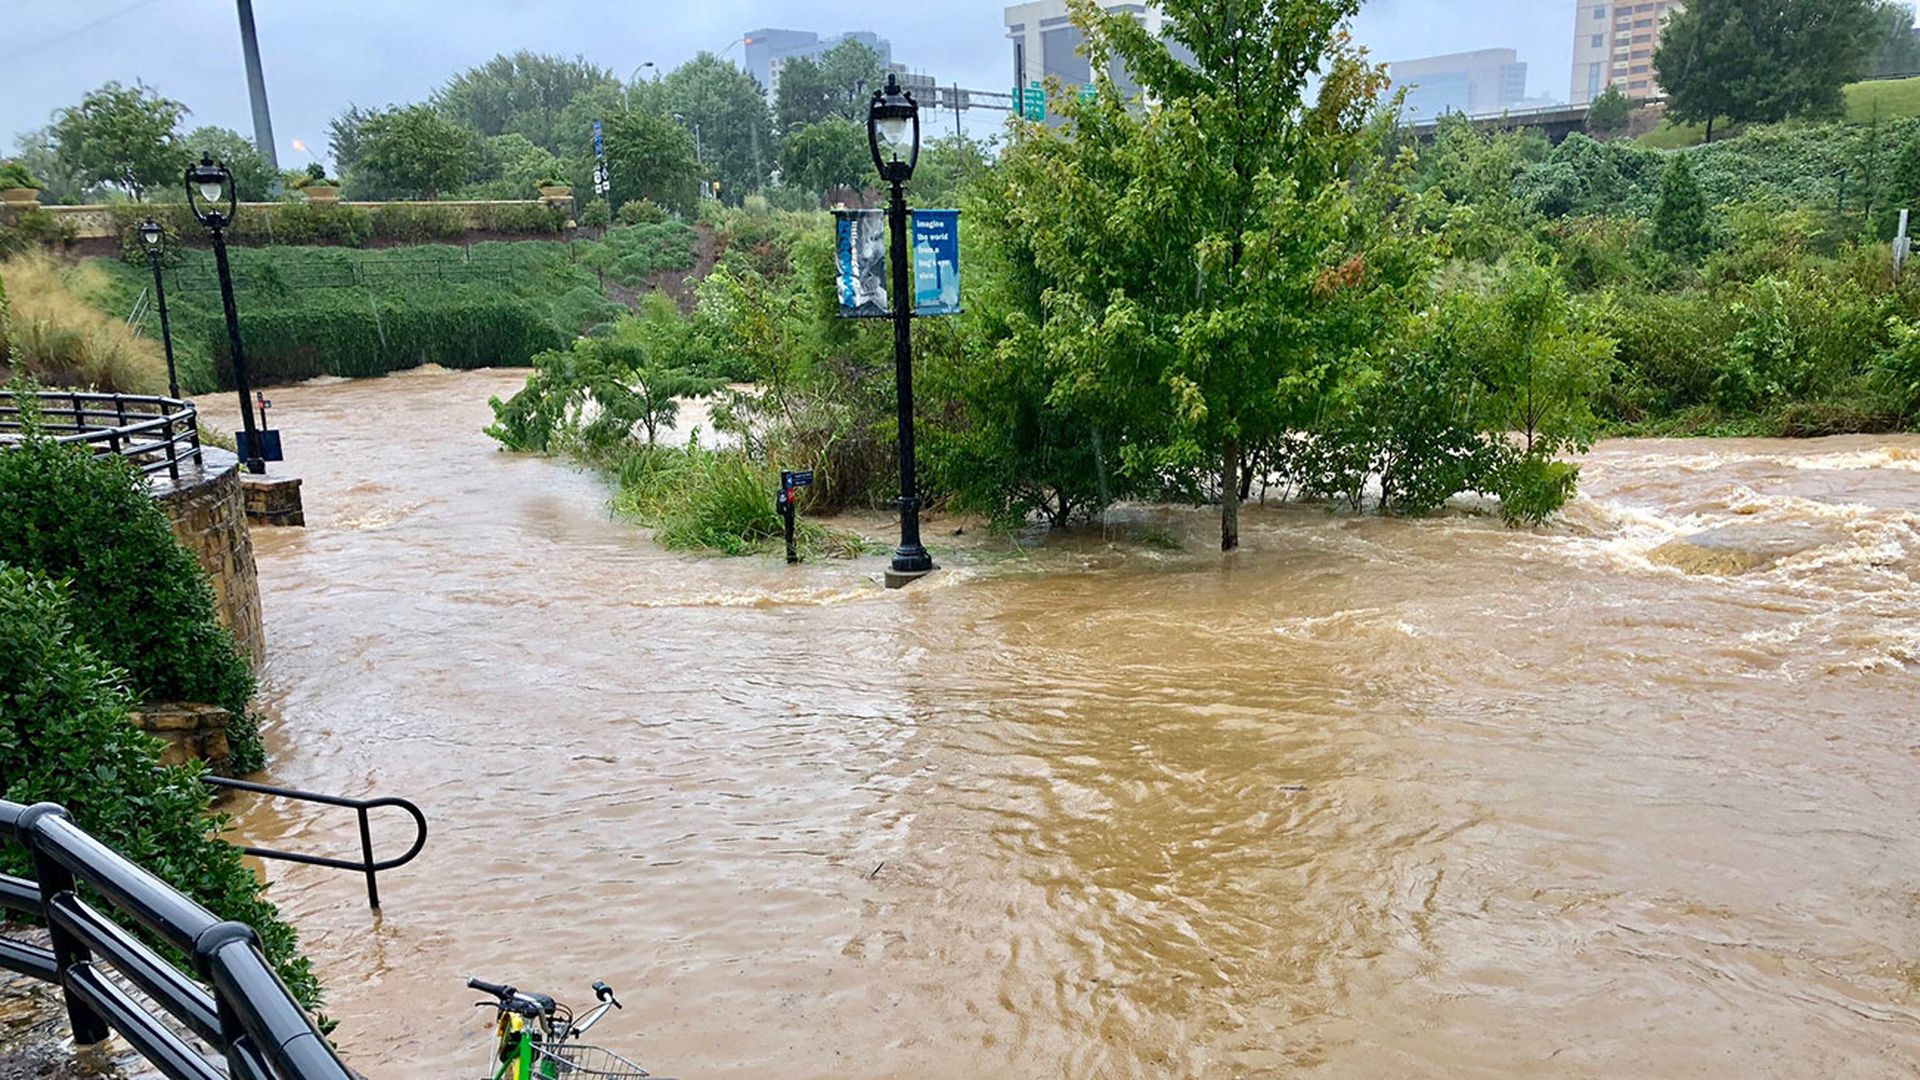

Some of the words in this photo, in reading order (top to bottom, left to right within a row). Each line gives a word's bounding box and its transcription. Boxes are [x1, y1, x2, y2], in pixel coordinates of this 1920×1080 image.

[916, 219, 944, 229] imagine
[917, 233, 928, 241] the
[930, 232, 949, 241] world
